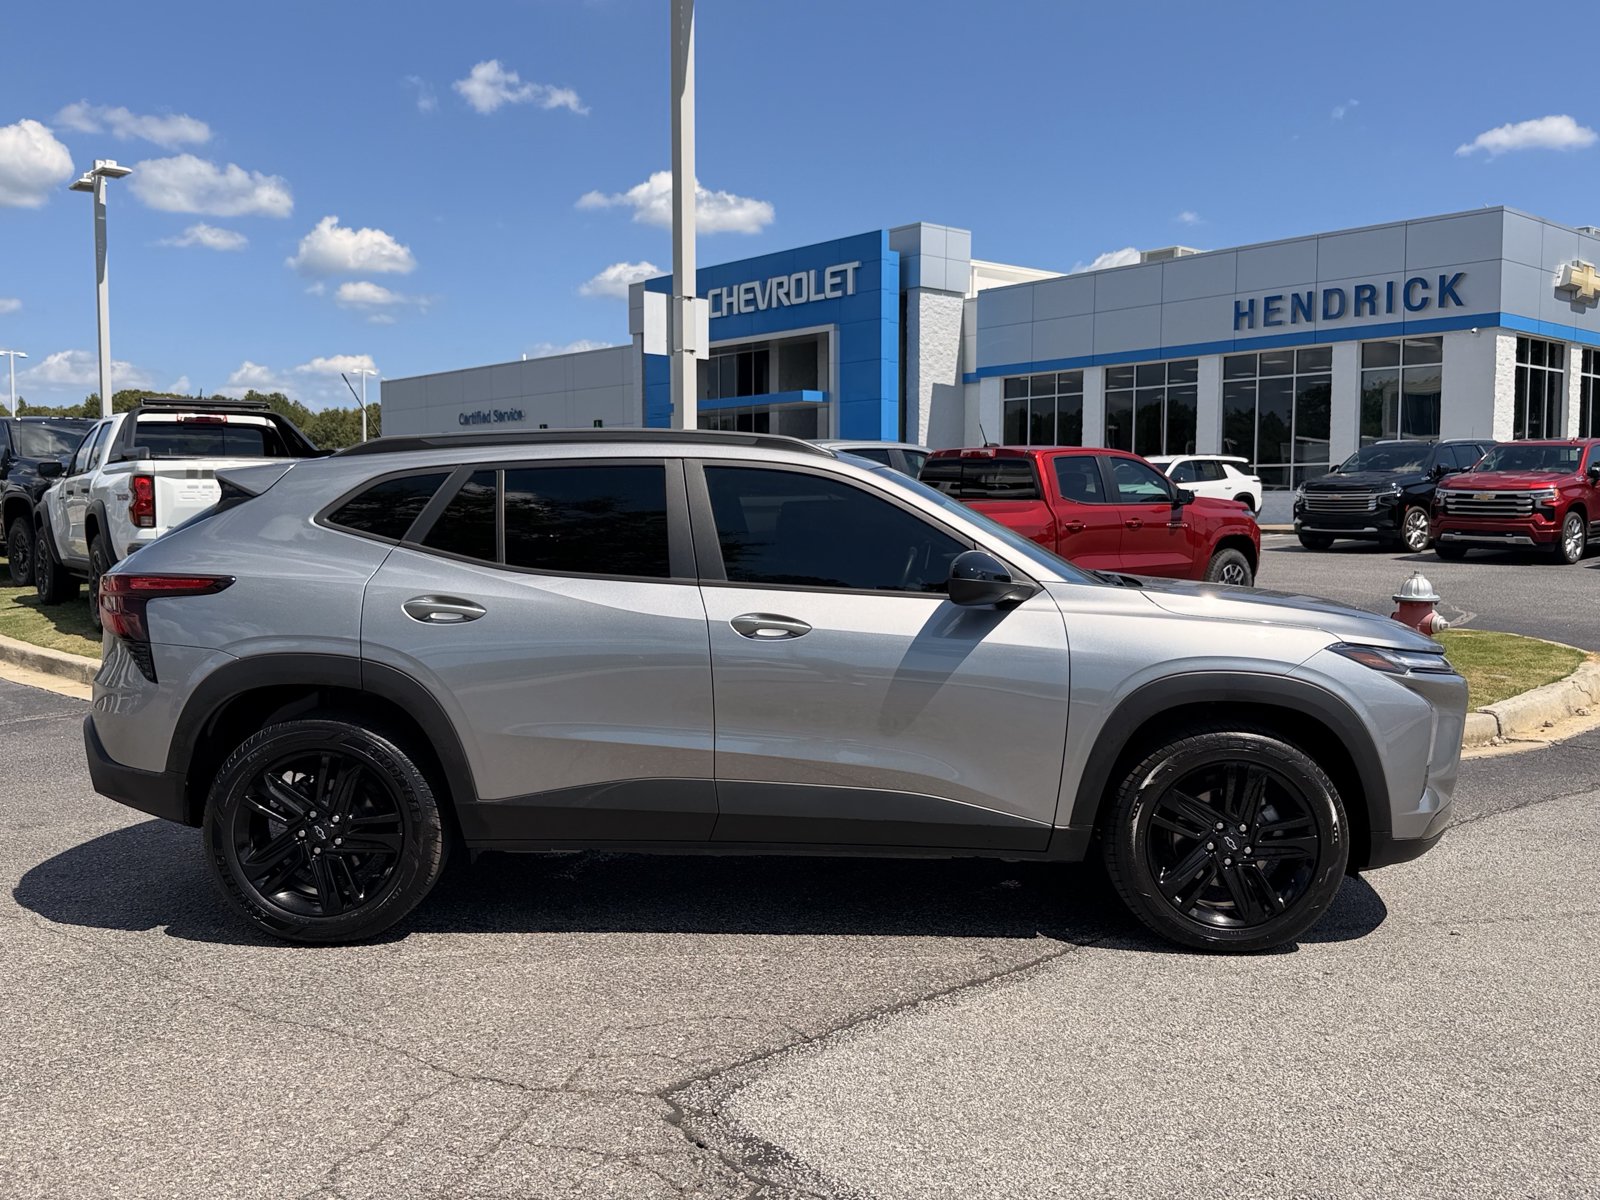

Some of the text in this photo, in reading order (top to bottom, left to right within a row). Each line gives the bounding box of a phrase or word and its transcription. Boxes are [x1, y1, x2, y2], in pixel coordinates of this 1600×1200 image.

[708, 261, 860, 318] CHEVROLET
[1233, 272, 1466, 330] HENDRICK
[458, 407, 524, 426] Certified Service
